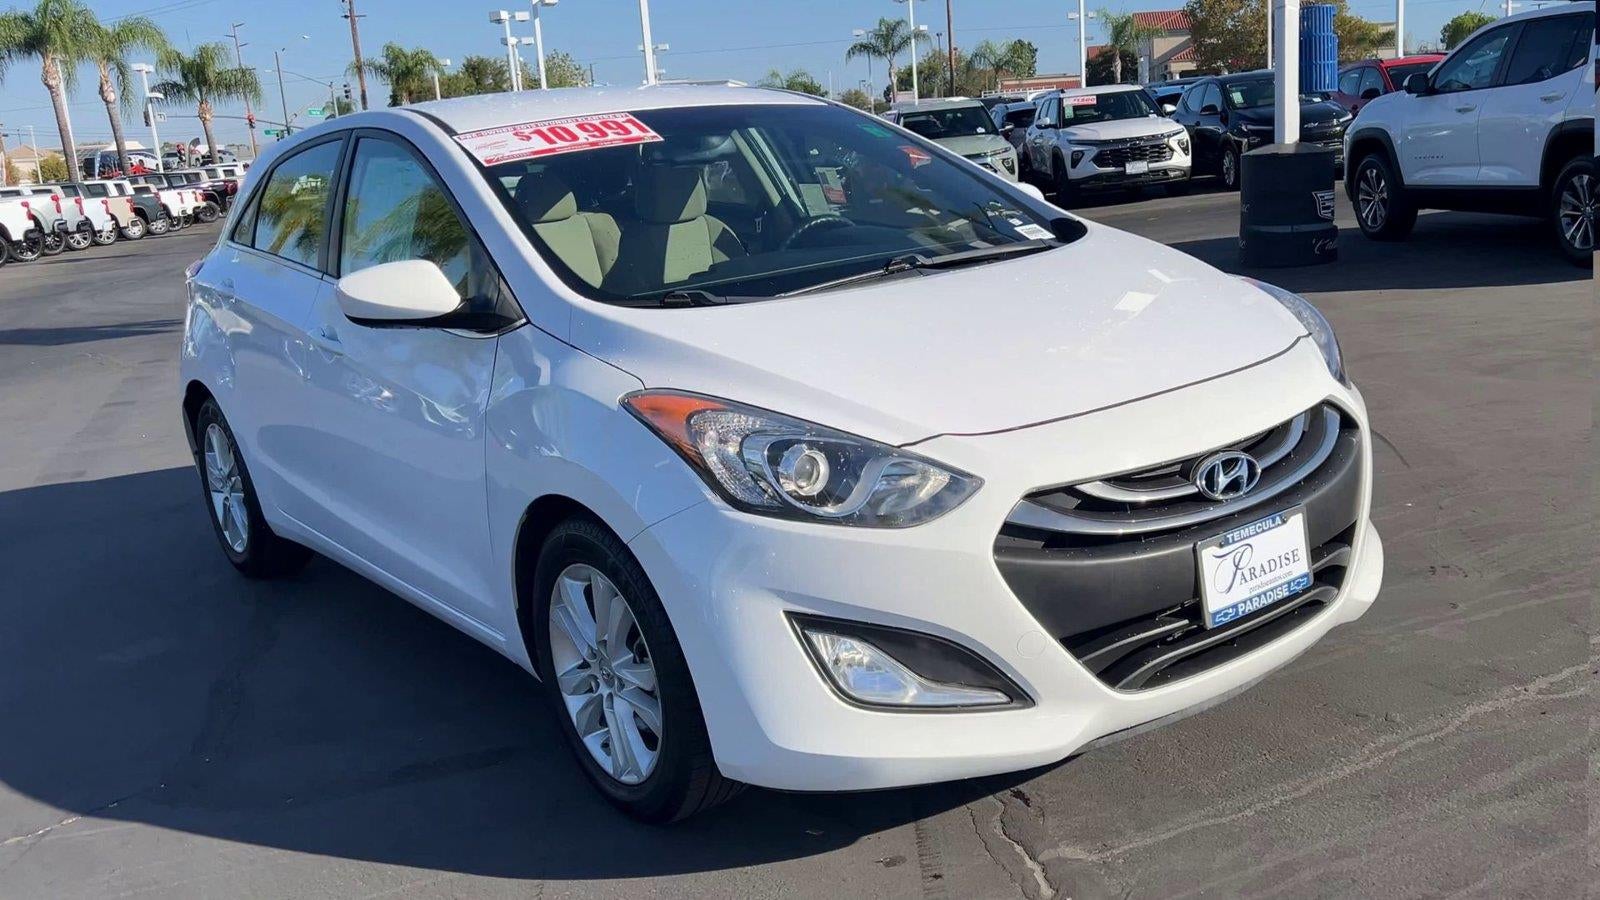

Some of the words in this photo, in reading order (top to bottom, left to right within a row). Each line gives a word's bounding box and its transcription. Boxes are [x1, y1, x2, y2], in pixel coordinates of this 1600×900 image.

[514, 118, 649, 145] $10,991
[1226, 516, 1282, 543] TEMECULA
[1213, 543, 1301, 595] PARADISE
[1238, 584, 1291, 616] PARADISE
